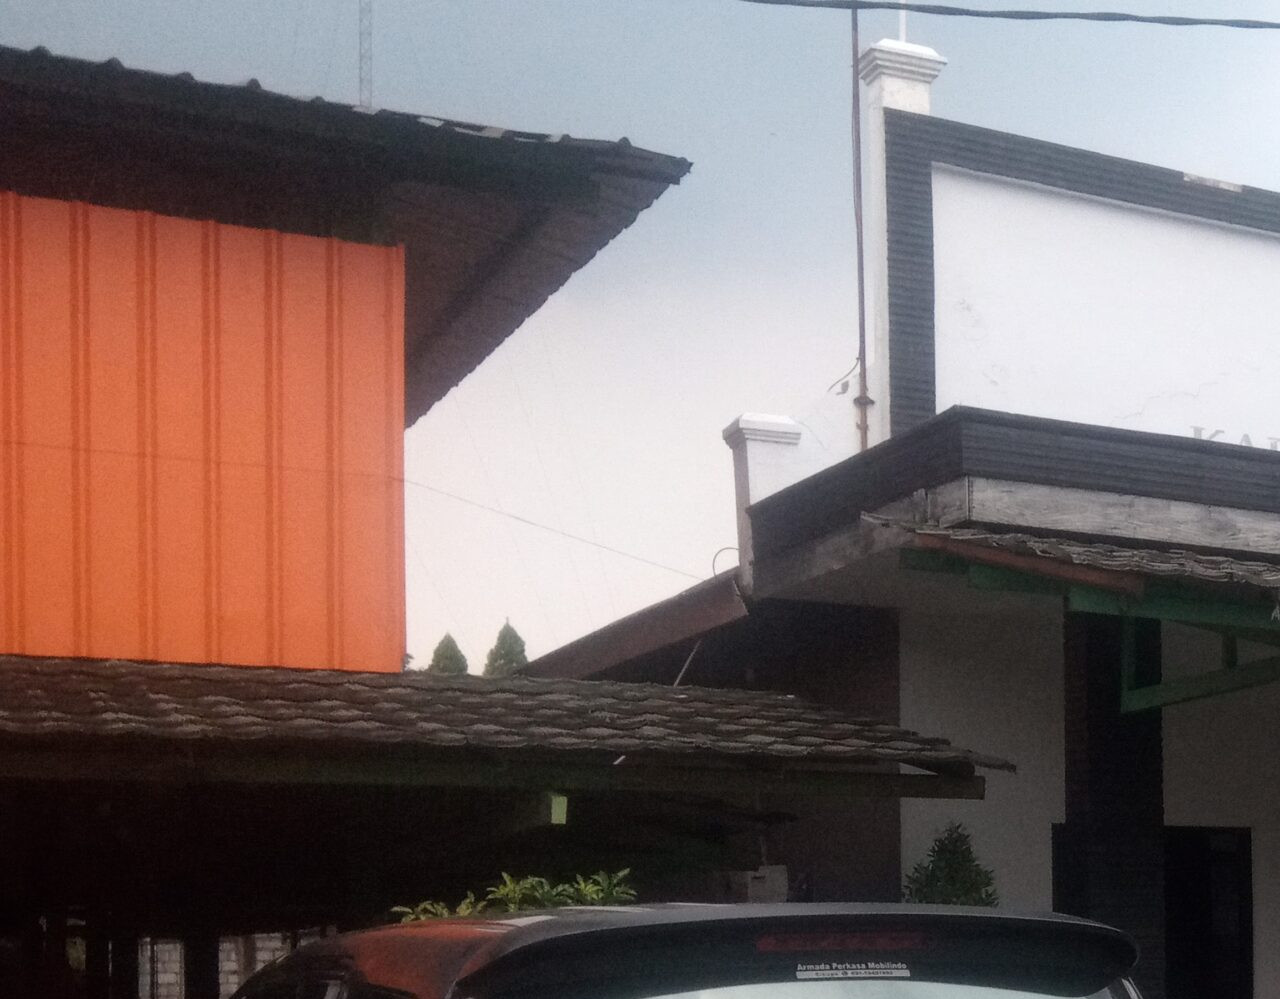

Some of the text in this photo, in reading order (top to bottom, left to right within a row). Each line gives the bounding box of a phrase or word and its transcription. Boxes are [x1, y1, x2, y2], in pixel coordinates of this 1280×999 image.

[797, 961, 908, 971] Armada Perkasa Mobilindo
